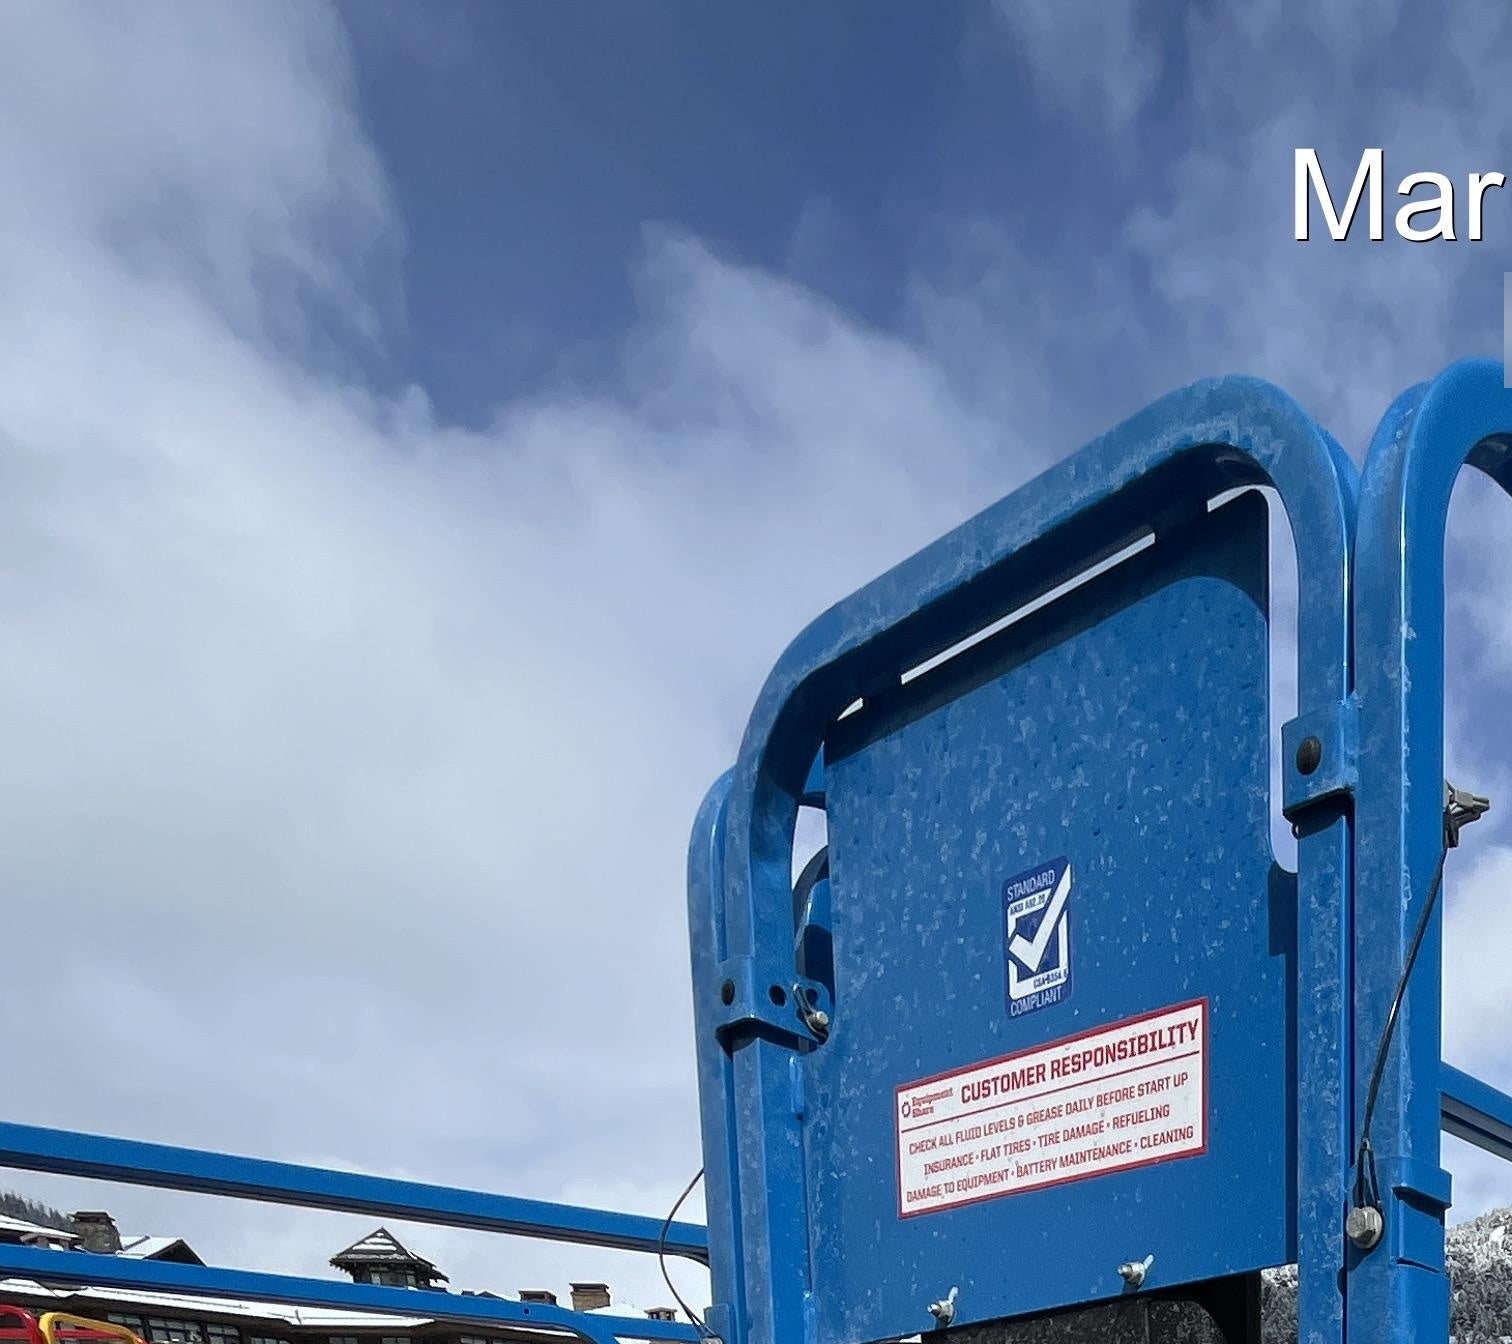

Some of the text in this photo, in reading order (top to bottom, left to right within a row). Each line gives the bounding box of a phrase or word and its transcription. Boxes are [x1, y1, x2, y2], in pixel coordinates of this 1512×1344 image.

[1007, 869, 1056, 902] STANDARD
[1010, 985, 1063, 1017] COMPLIANT
[961, 1018, 1199, 1104] CUSTOMER RESPONSIBILITY
[909, 1137, 937, 1155] CHECK
[939, 1134, 954, 1148] ALL
[956, 1126, 982, 1144] FLUID
[984, 1118, 1016, 1136] LEVELS
[1026, 1105, 1063, 1125] GREASE
[1066, 1096, 1095, 1115] DAILY
[1096, 1086, 1135, 1108] BEFORE
[1138, 1076, 1171, 1097] START
[1173, 1072, 1189, 1088] UP
[924, 1104, 1170, 1175] INSURANCE FLAT TIRES TIRE DAMAGE REFUELING
[907, 1125, 1194, 1203] DAMAGE TO EQUIPMENT BATTERY MAINTENANCE CLEANING
